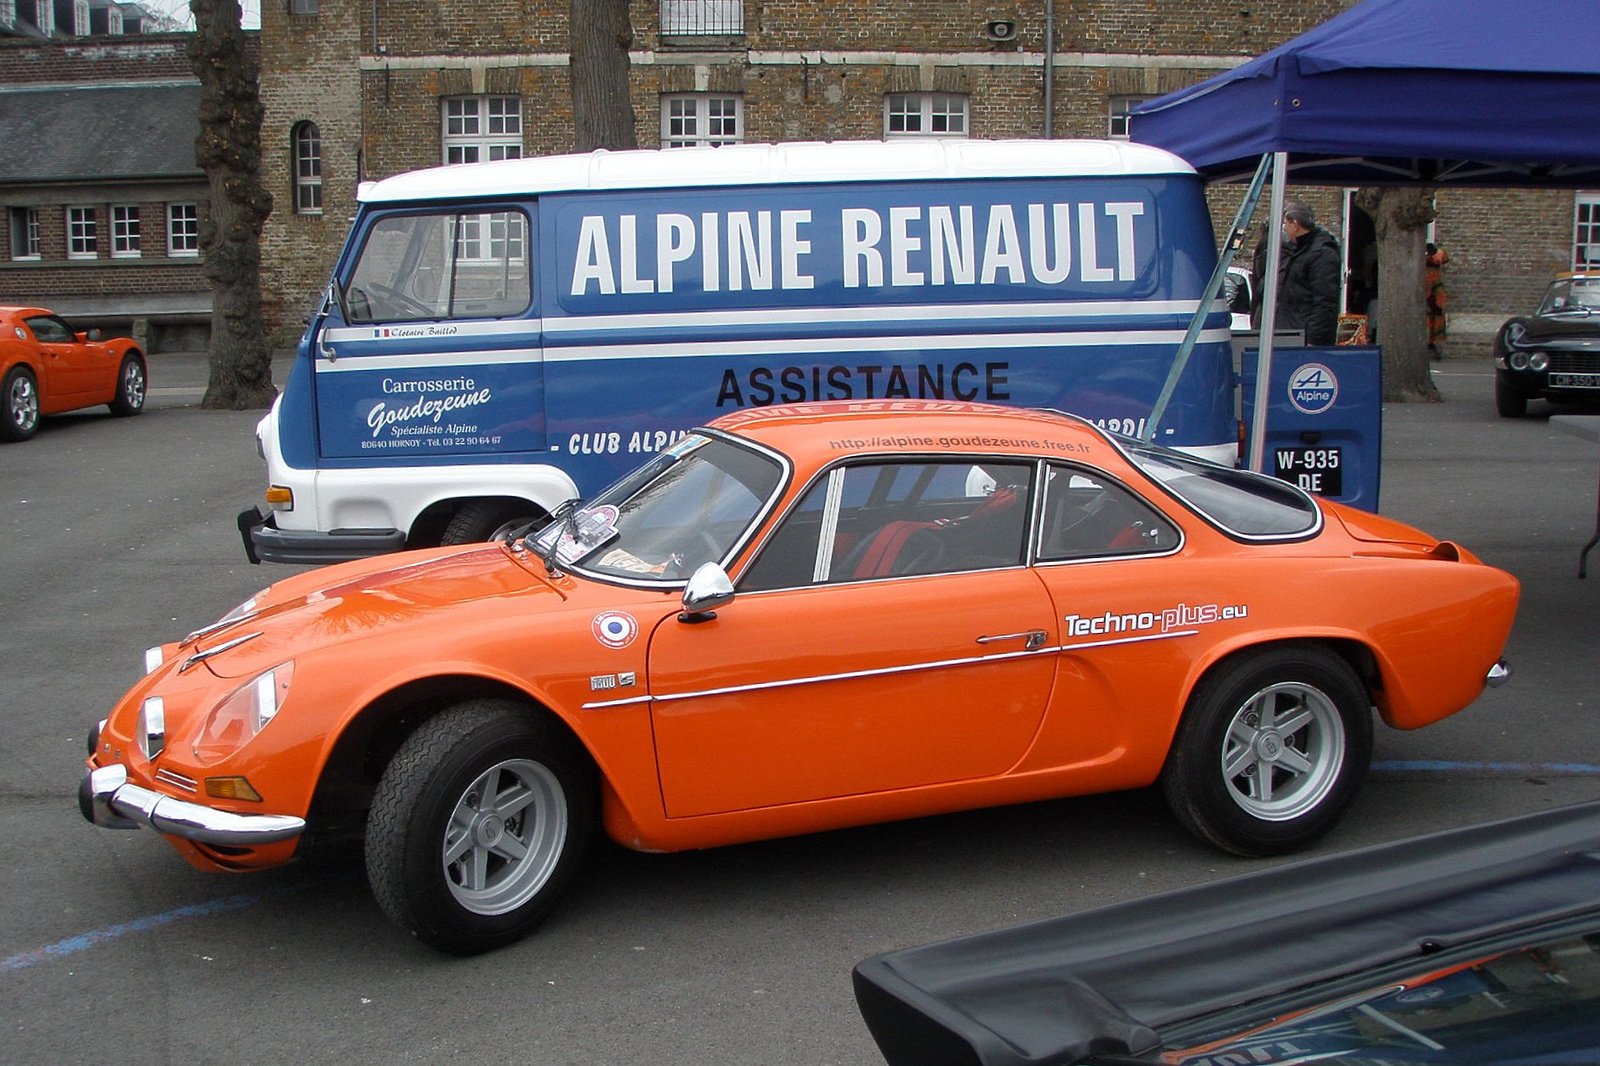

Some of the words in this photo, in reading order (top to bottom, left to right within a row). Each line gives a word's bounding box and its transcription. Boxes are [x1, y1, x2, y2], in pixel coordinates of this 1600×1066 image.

[570, 209, 815, 296] ALPINE
[841, 201, 1145, 289] RENAULT
[382, 376, 475, 393] Carrosserie
[715, 361, 1010, 408] ASSISTANCE
[1296, 391, 1330, 403] Alpine
[367, 388, 492, 437] Goudezeune
[391, 425, 443, 437] Spécialiste
[445, 423, 478, 435] Alpine
[442, 437, 454, 446] 03
[455, 437, 465, 446] 22
[568, 433, 621, 455] CLUB
[627, 429, 691, 454] ALPI
[829, 435, 1091, 454] http://alpine.goudezeune.free.fr
[1277, 449, 1339, 469] W-935
[1065, 603, 1248, 637] Techno-plus.eu
